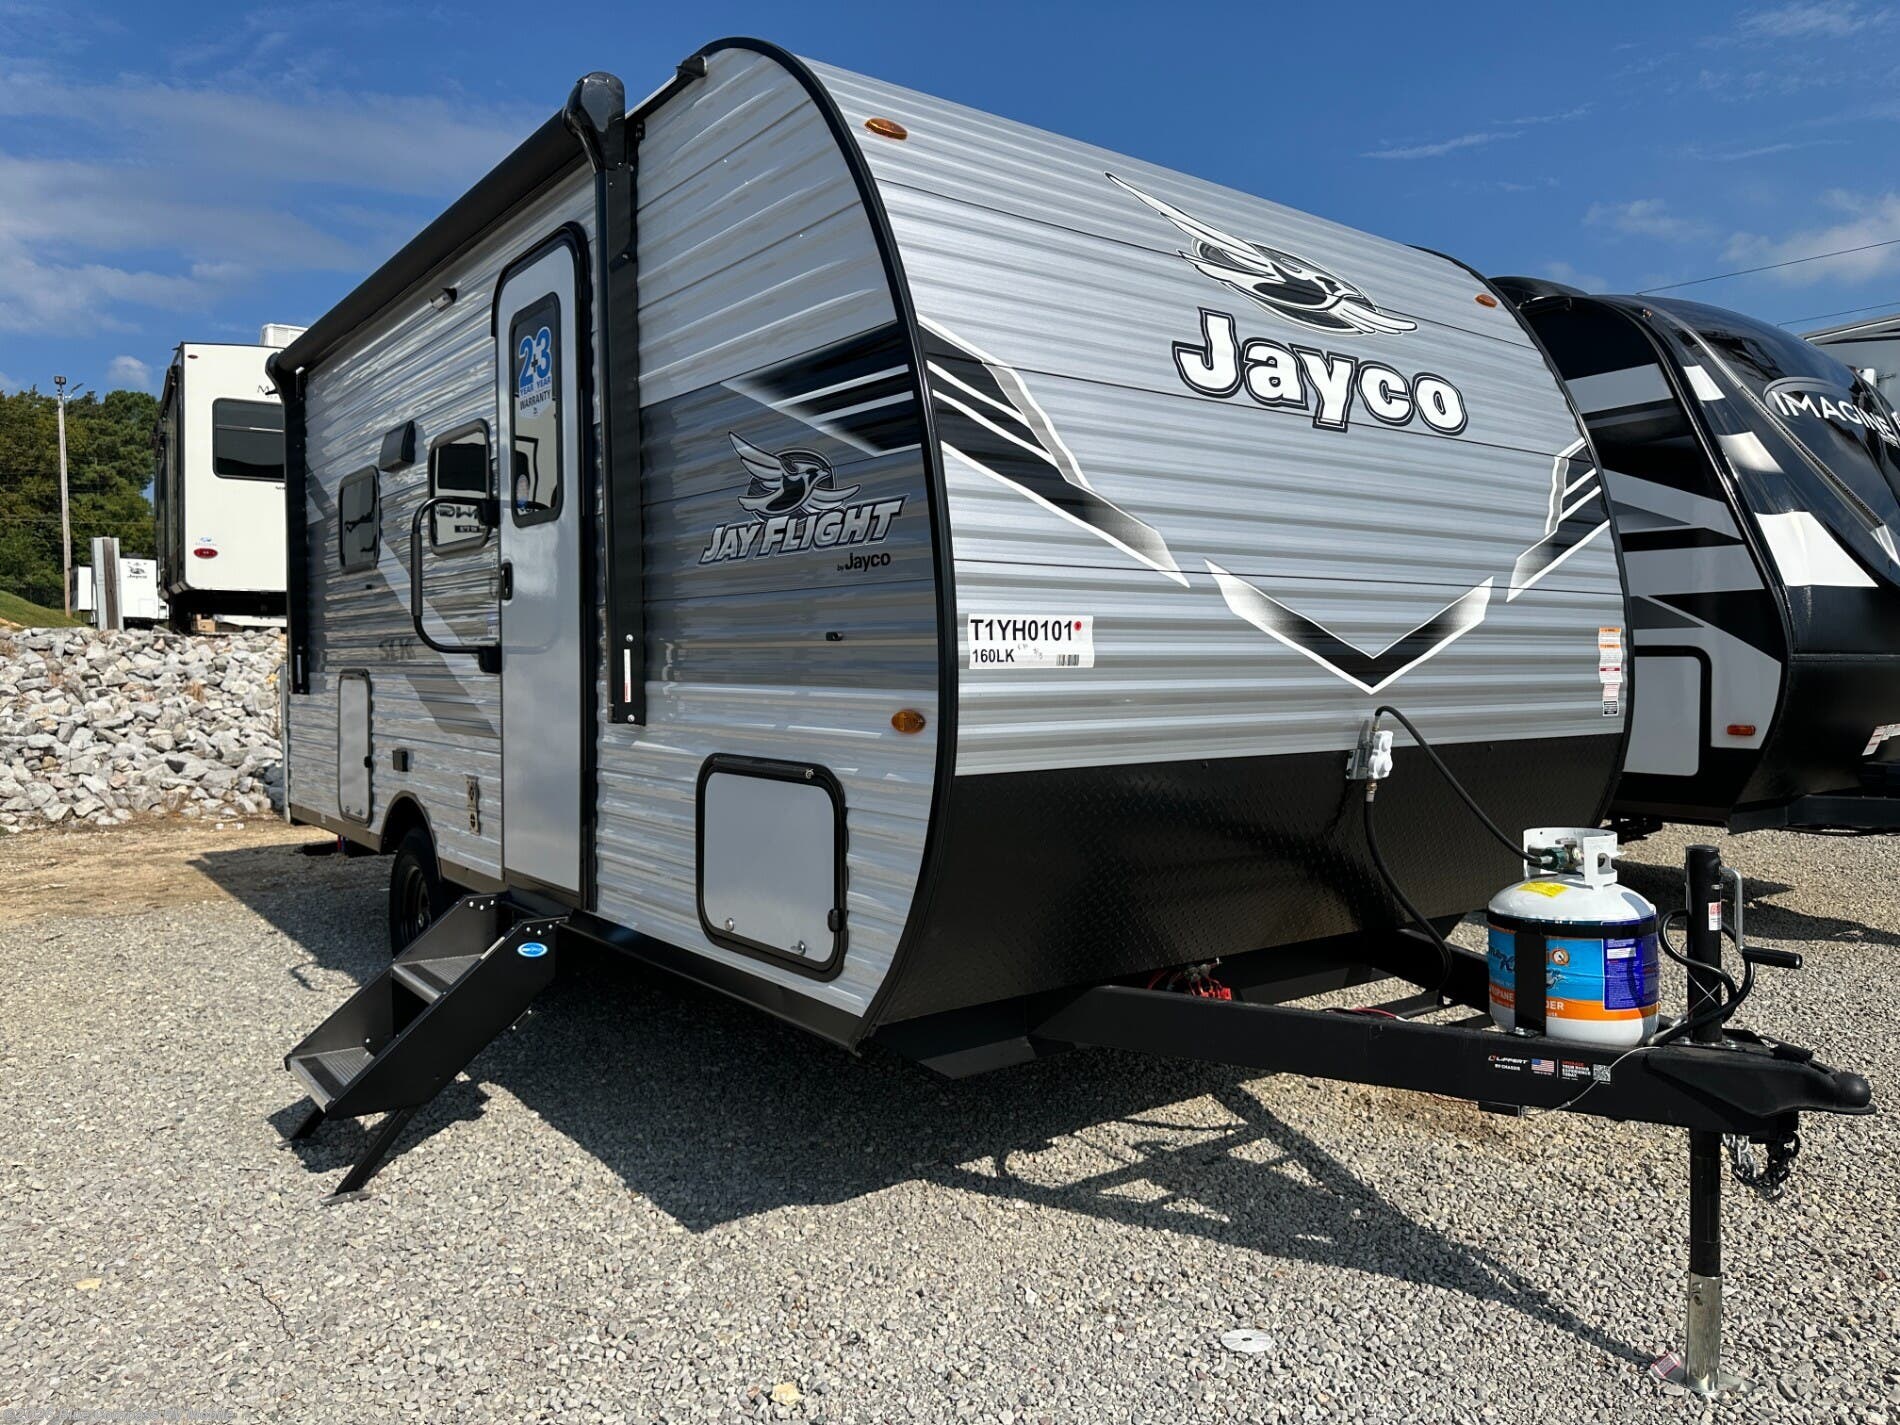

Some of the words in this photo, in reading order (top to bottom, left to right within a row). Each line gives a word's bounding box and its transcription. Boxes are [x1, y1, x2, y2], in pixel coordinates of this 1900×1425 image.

[1172, 307, 1467, 435] Jayco
[520, 383, 534, 397] YEAR
[537, 375, 551, 389] YEAR
[520, 390, 551, 410] WARRANTY
[1771, 389, 1898, 441] IMAGINE
[697, 522, 764, 566] JAY
[754, 494, 910, 560] FLIGHT
[845, 553, 891, 572] Jayco
[970, 619, 1073, 641] T1YH0101
[972, 648, 1015, 662] 160LK
